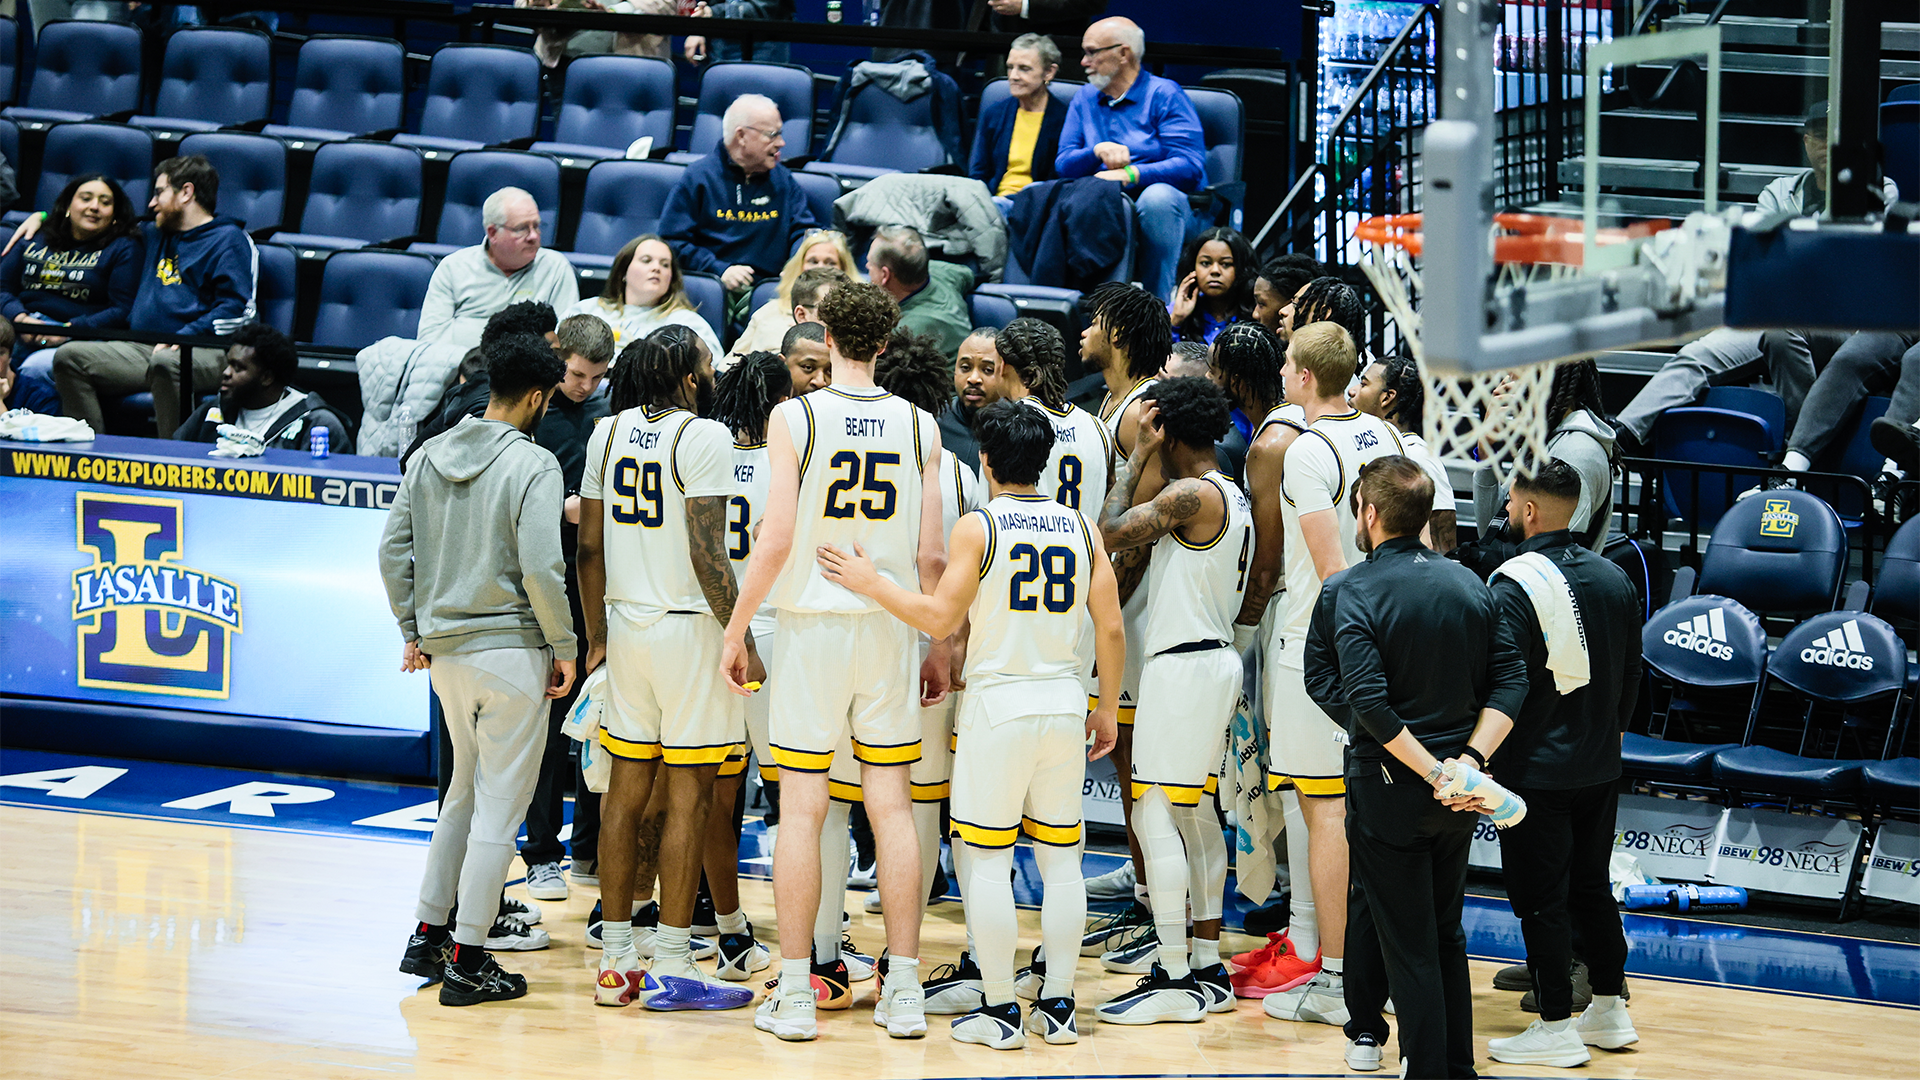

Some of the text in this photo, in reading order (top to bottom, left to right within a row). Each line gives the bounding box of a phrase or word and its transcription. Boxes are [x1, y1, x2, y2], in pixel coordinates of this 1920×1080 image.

[23, 242, 49, 260] LA
[845, 417, 885, 437] BEATTY
[12, 451, 315, 499] WWW.GOEXPLORERS.COM/NIL
[734, 465, 754, 482] KER
[822, 449, 901, 521] 25
[1055, 453, 1083, 511] 8
[612, 456, 664, 529] 99
[729, 494, 751, 561] 3
[1236, 524, 1251, 593] 4
[1008, 542, 1077, 614] 28
[1663, 630, 1734, 661] adidas
[1800, 646, 1874, 671] adidas
[1474, 822, 1497, 842] 98
[1624, 830, 1706, 857] 98 NECA
[1718, 845, 1752, 858] IBEW
[1758, 846, 1784, 866] 98
[1784, 852, 1840, 874] NECA
[1871, 857, 1905, 871] IBEW
